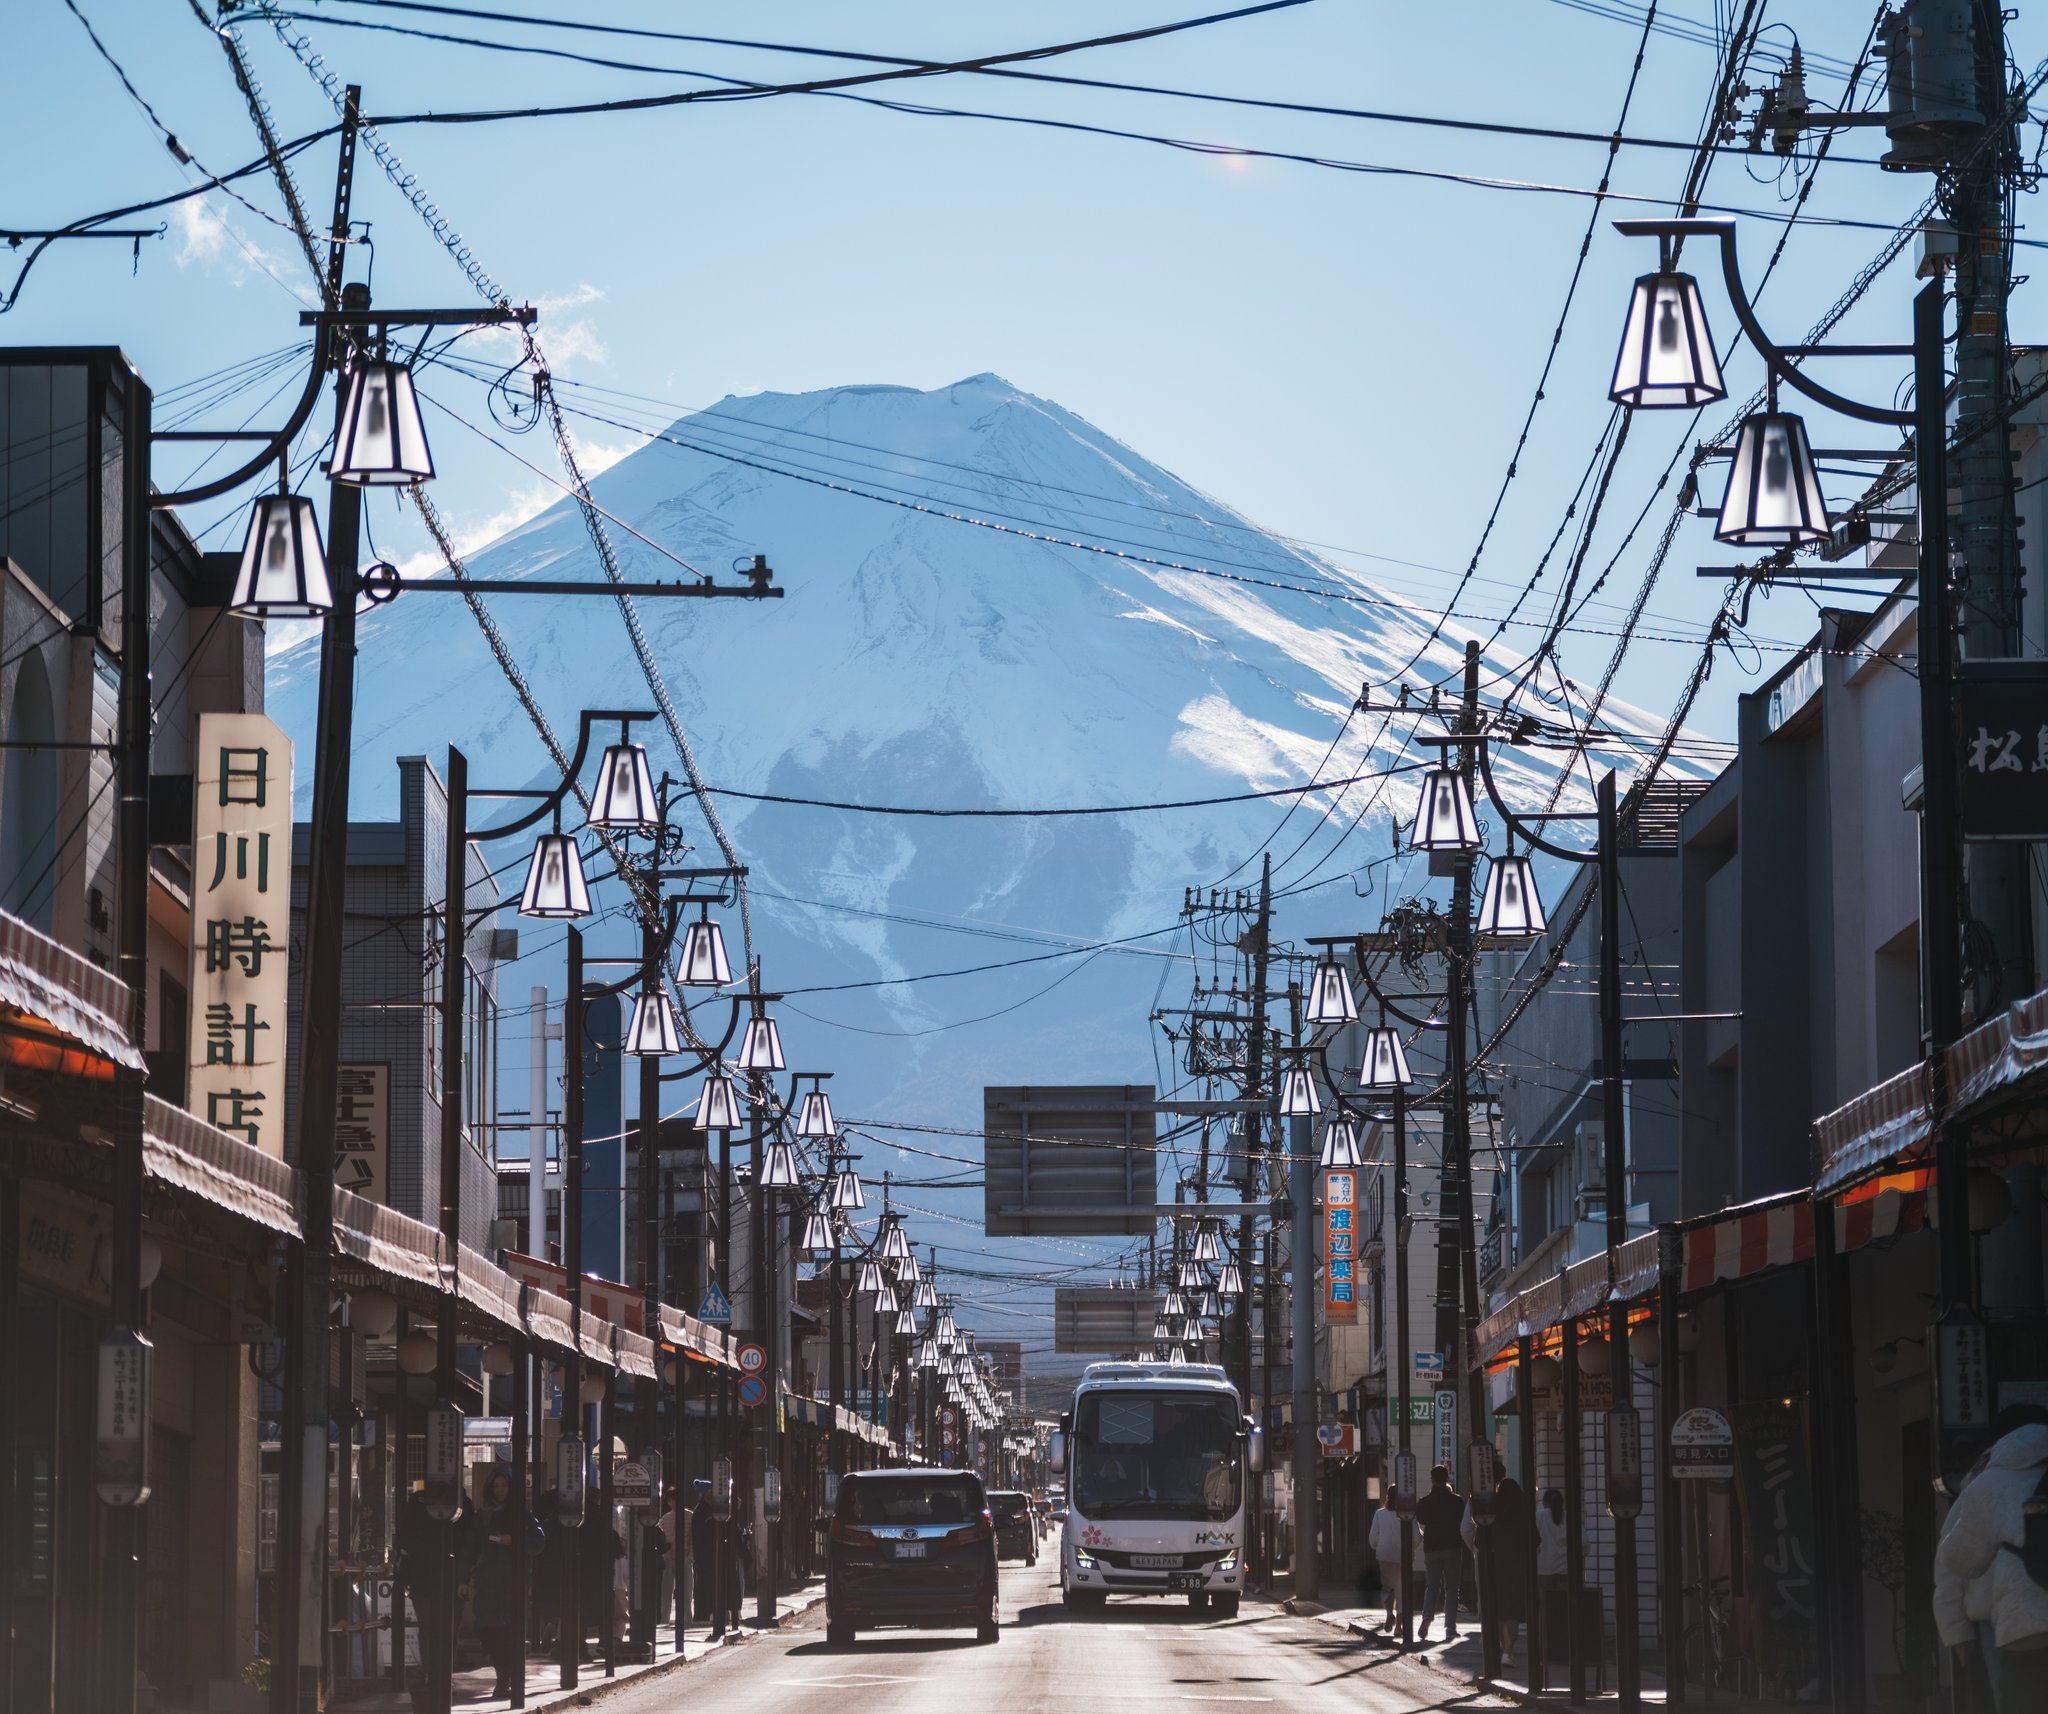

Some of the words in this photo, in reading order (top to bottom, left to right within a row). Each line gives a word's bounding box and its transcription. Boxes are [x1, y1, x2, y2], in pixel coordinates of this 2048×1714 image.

[207, 746, 271, 1146] 日川時計店
[1329, 1208, 1353, 1304] 渡辺薬局
[743, 1352, 760, 1366] 40
[1675, 1447, 1729, 1459] 明見入口
